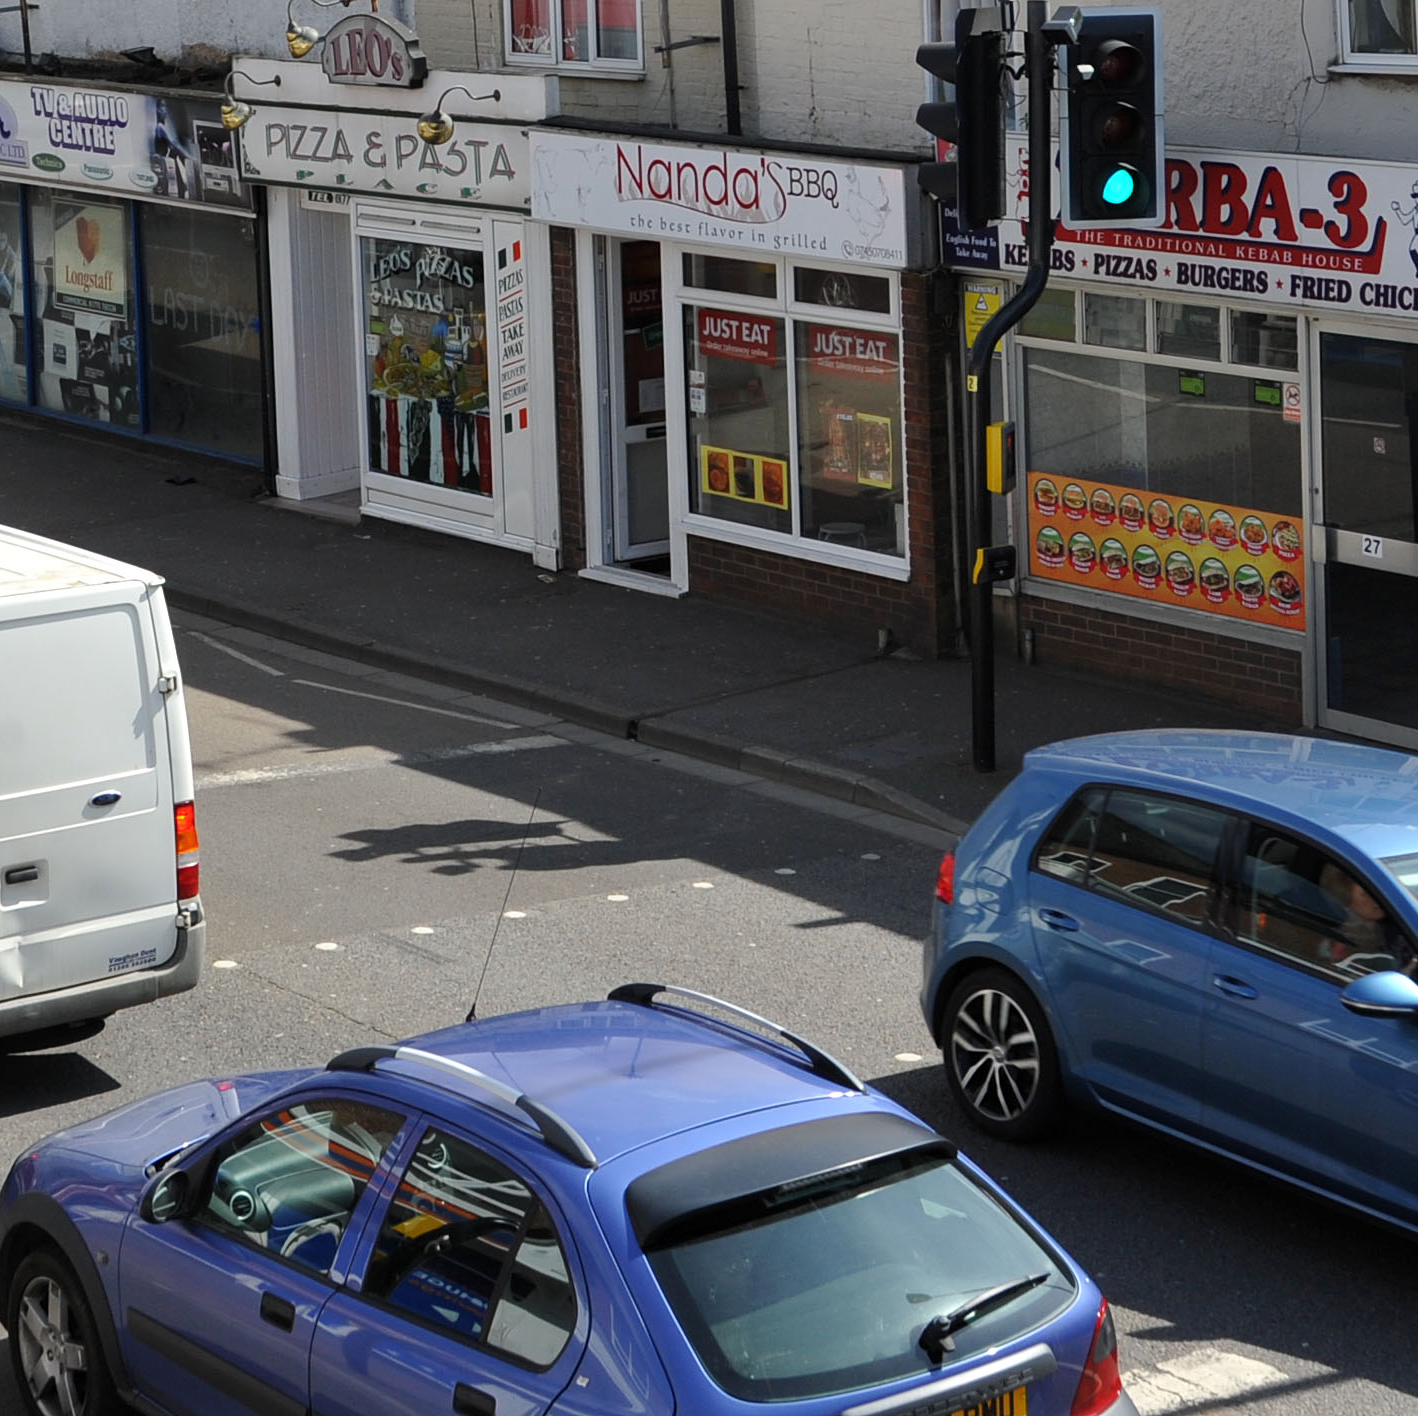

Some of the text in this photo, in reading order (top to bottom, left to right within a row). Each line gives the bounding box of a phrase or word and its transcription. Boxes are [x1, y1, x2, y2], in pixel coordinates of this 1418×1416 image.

[31, 86, 129, 128] TV & AUDIO
[48, 117, 115, 155] CENTRE
[266, 123, 515, 185] PIZZA & PASTA
[786, 167, 839, 209] BBQ
[1165, 159, 1369, 249] RBA-3
[631, 214, 828, 250] the best flavor in grilled
[946, 233, 997, 247] English Food To
[956, 247, 988, 261] Take Away
[1074, 230, 1364, 271] THE TRADITIONAL KEBAB HOUSE
[65, 265, 114, 293] Longstaff
[498, 268, 524, 295] PIZZAS
[1004, 244, 1075, 272] KEBS
[1093, 253, 1157, 281] PIZZAS
[1177, 262, 1268, 294] BURGERS
[1289, 274, 1352, 304] FRIED
[383, 287, 444, 314] PASTAS
[627, 288, 659, 304] JUST
[967, 284, 997, 295] WARNING
[150, 286, 204, 333] LAST
[499, 297, 524, 323] PASTAS
[501, 323, 525, 344] TAKE
[703, 316, 771, 345] JUST EAT
[502, 340, 524, 361] AWAY
[706, 341, 722, 351] Order
[751, 347, 768, 358] online
[814, 333, 887, 362] JUST EAT
[1364, 536, 1381, 555] 27
